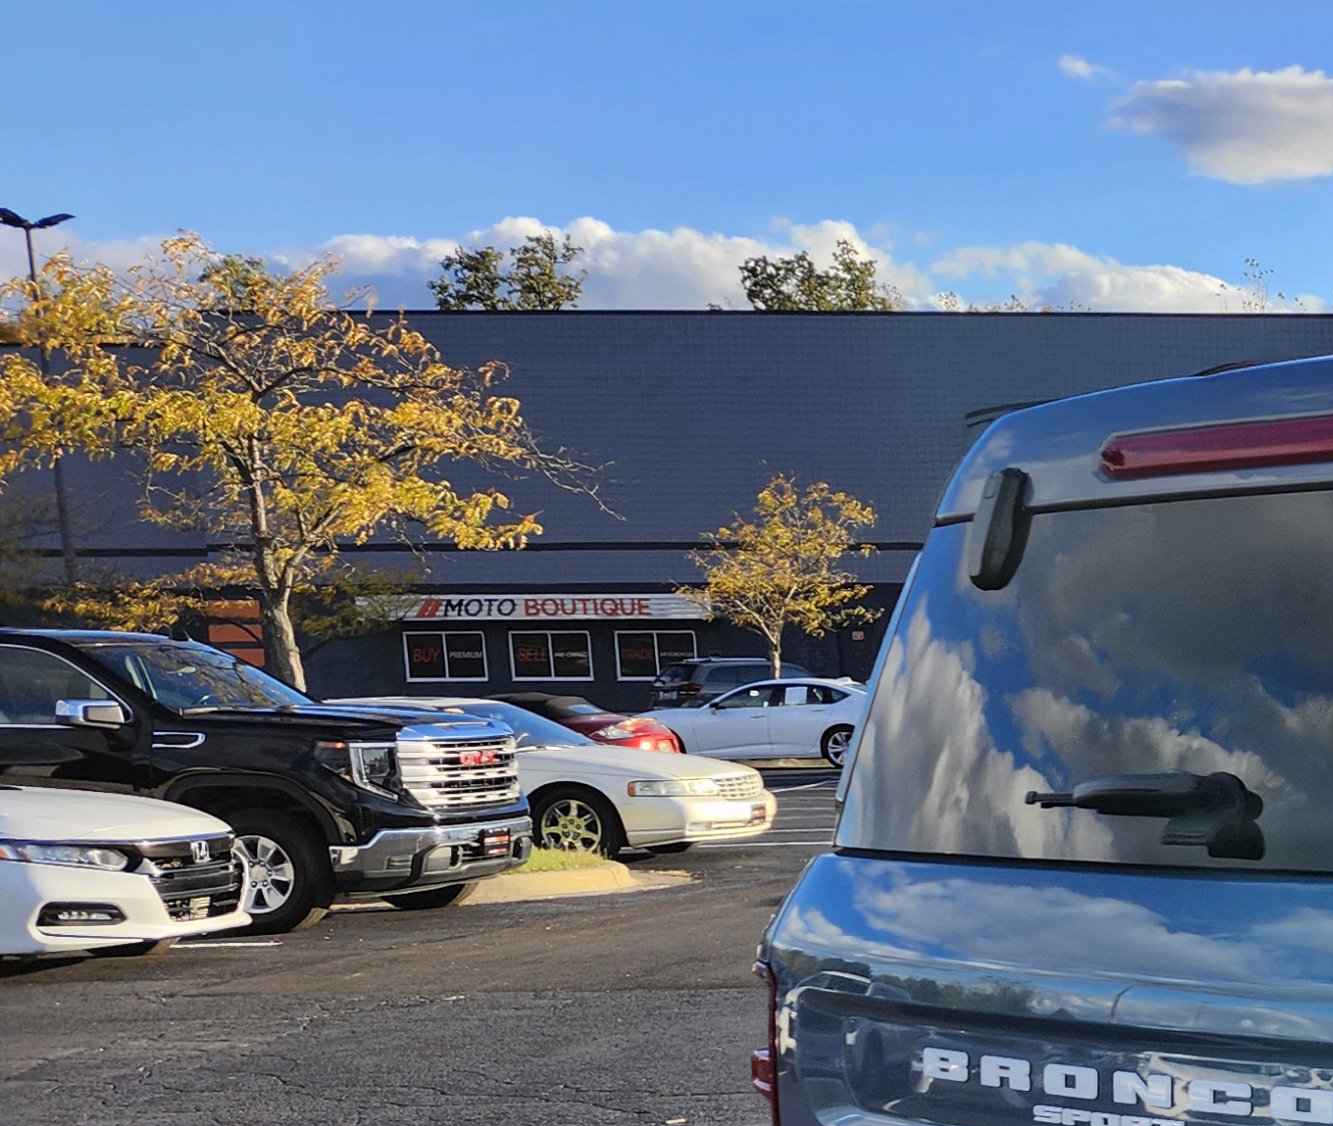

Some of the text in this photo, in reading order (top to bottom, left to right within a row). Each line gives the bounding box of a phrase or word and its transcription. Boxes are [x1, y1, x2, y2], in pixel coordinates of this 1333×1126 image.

[443, 597, 653, 617] MOTO BOUTIQUE
[412, 648, 441, 662] BUY
[449, 650, 483, 659] PREMIUM
[518, 648, 548, 662] SELL
